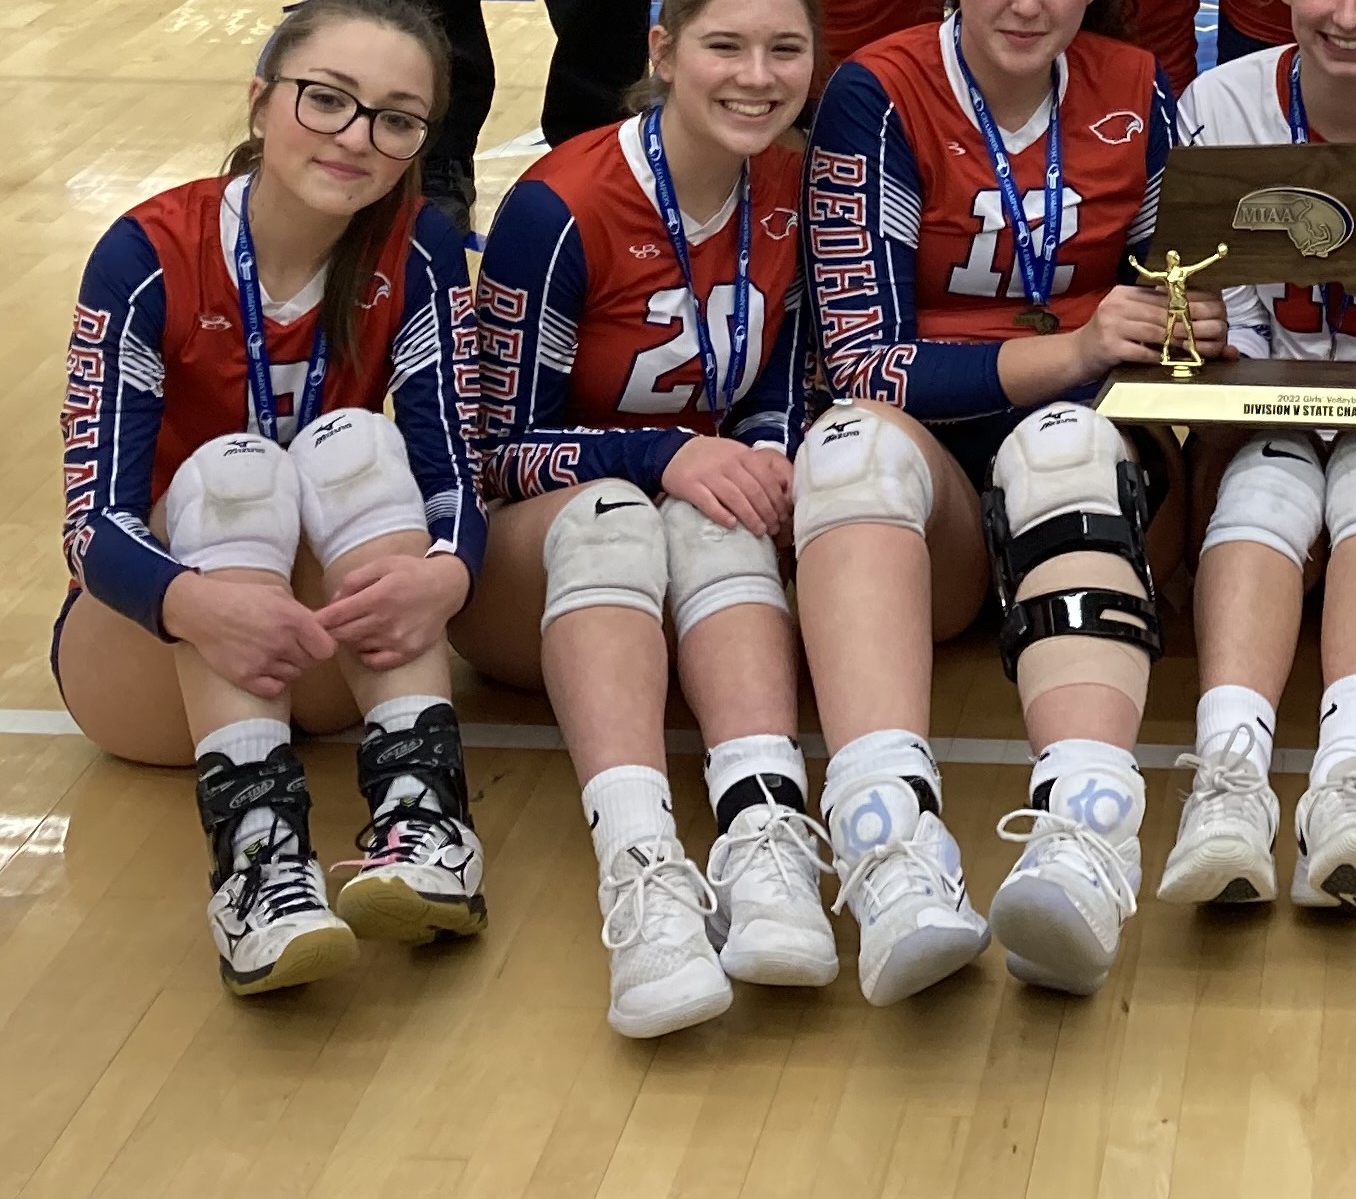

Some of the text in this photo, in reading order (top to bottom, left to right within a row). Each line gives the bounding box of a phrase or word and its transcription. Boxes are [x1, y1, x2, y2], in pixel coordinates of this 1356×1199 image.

[979, 111, 1000, 152] CHAMPION
[653, 161, 671, 207] CHAMPION
[1003, 177, 1021, 221] CHAMPION
[1048, 189, 1057, 235] CHAMPION
[1240, 206, 1295, 224] MIAA
[948, 188, 1082, 298] 12
[246, 283, 256, 331] CHAMPION
[617, 284, 765, 414] 20
[254, 361, 267, 410] CHAMPION
[1277, 394, 1301, 403] 2022
[1243, 403, 1290, 416] DIVISION
[1293, 404, 1300, 416] V
[1303, 405, 1334, 417] STATE
